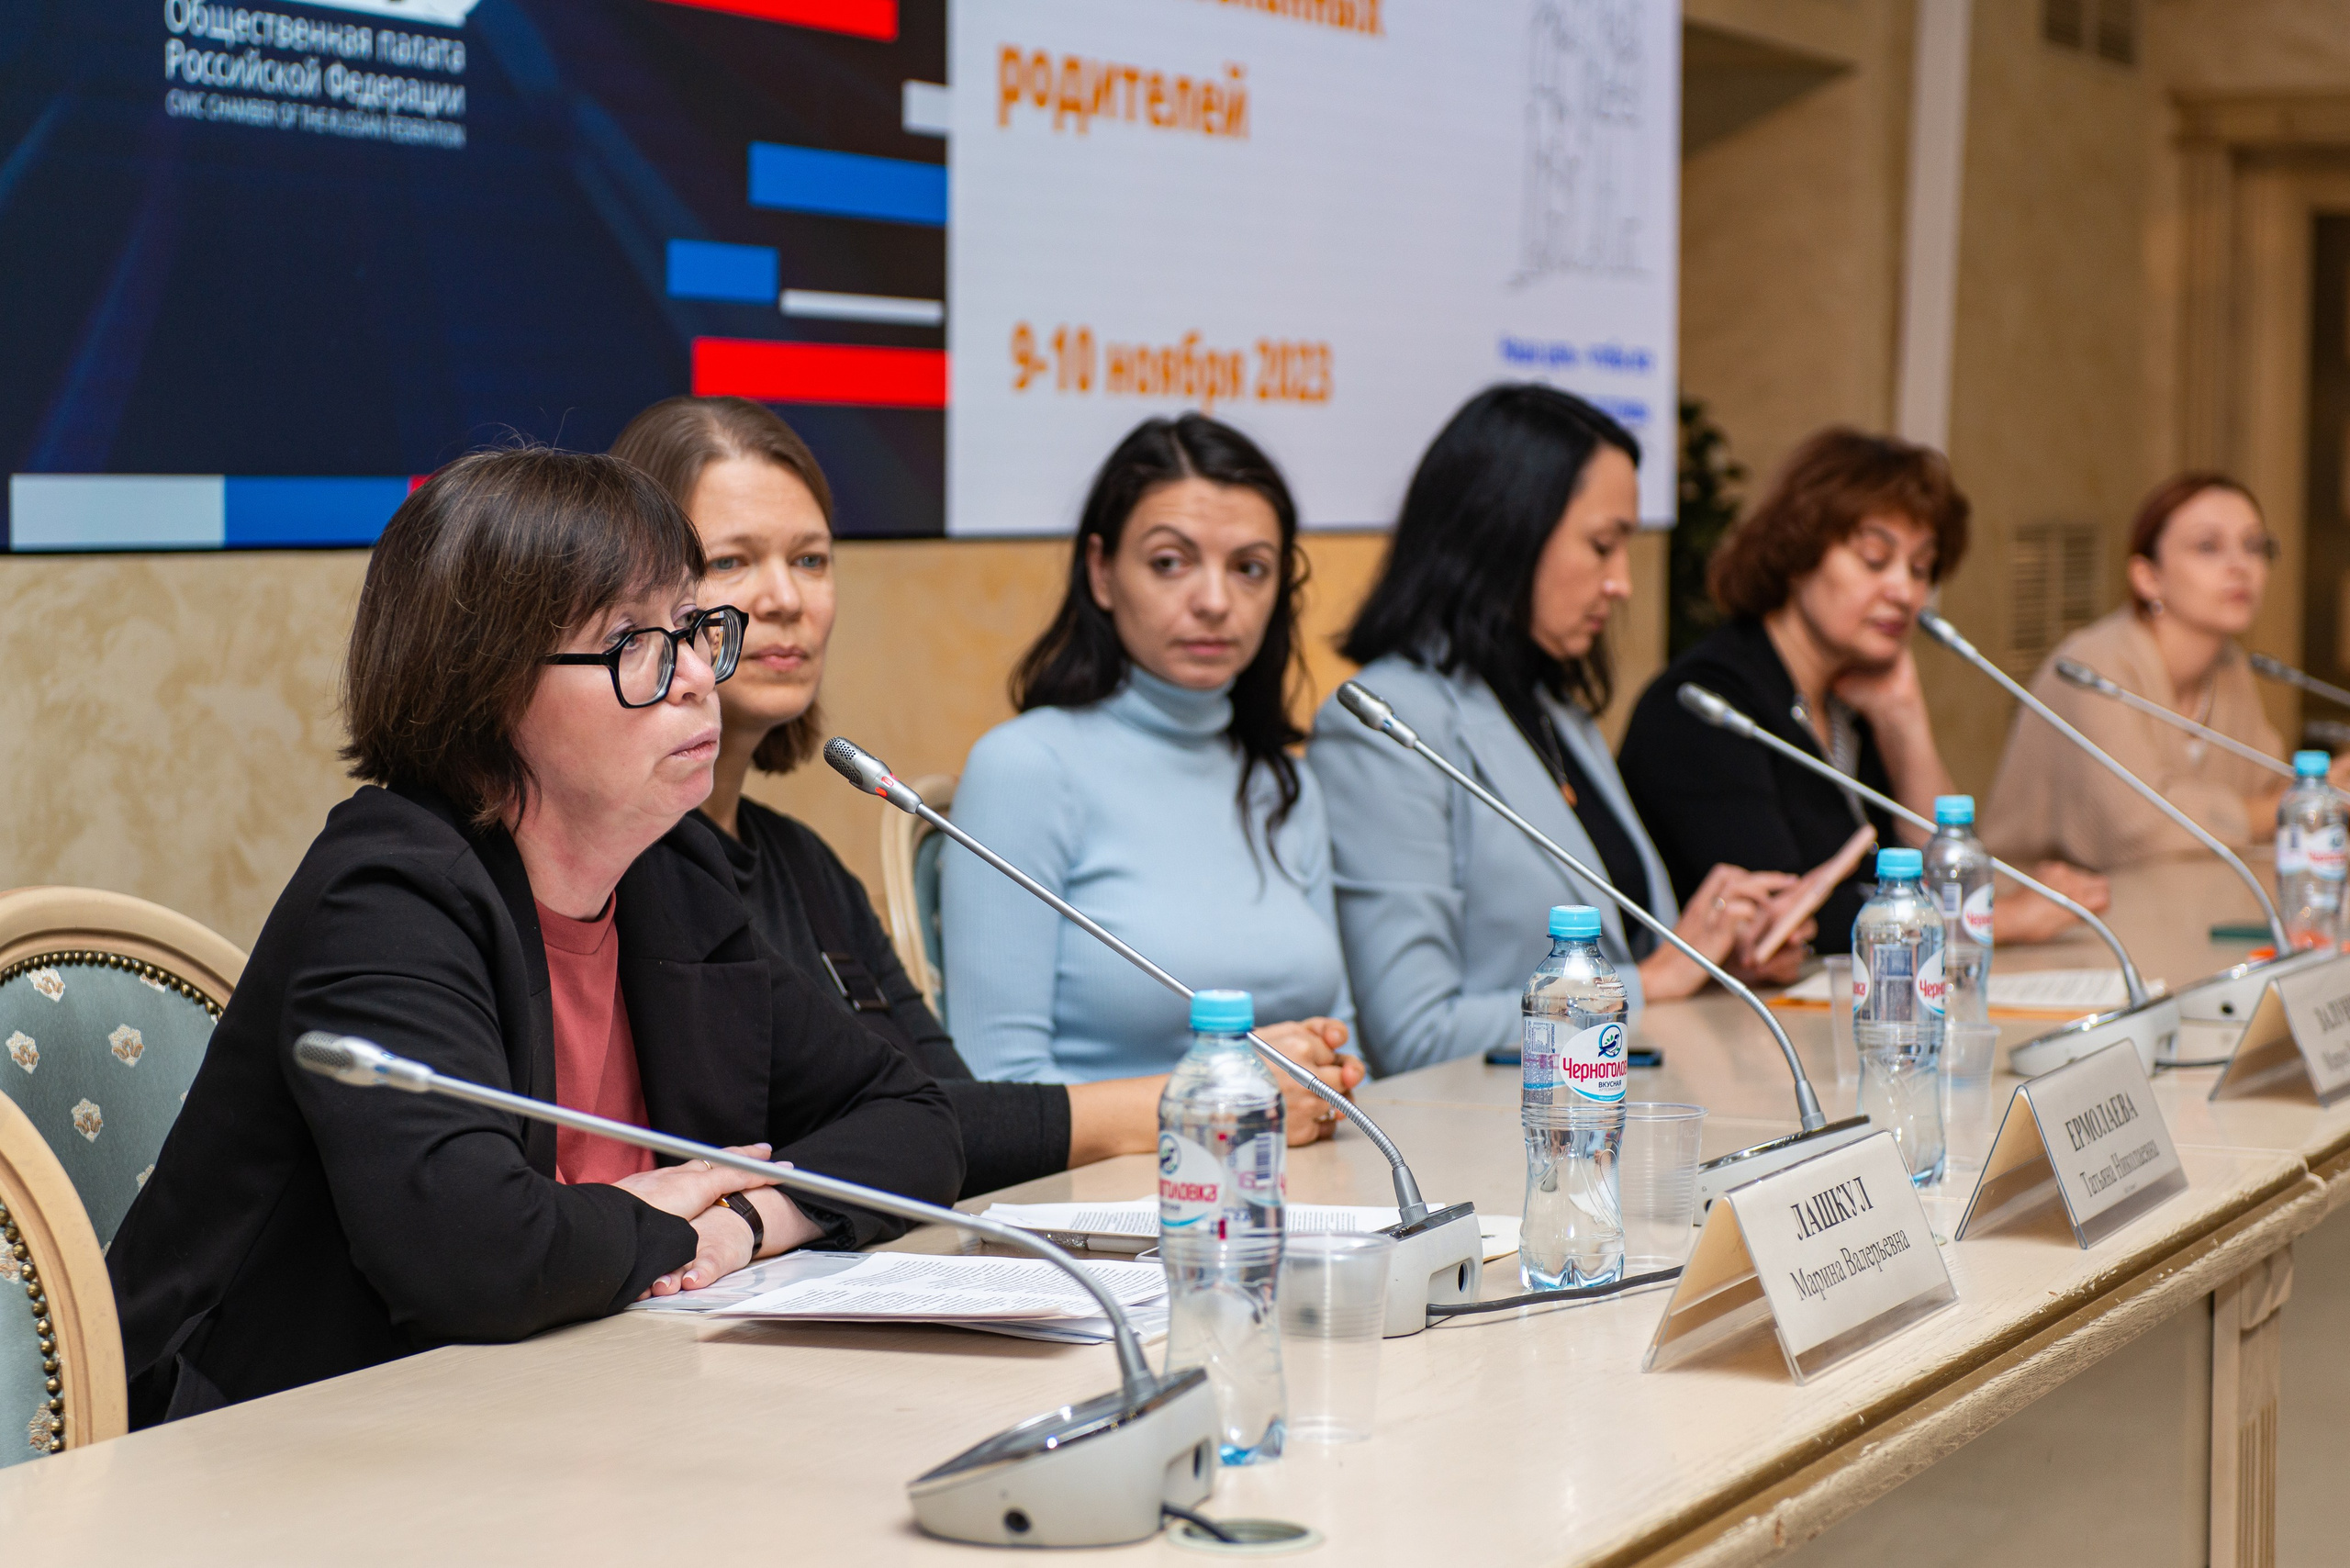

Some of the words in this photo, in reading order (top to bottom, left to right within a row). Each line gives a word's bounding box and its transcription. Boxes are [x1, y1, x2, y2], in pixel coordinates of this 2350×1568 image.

[164, 0, 373, 58] Общественная
[375, 30, 466, 73] палата
[165, 38, 321, 97] Российской
[324, 61, 466, 118] Федерации
[998, 44, 1250, 140] родителей
[1012, 321, 1096, 395] 9-10
[1106, 329, 1244, 416] ноября
[1254, 339, 1334, 405] 2023
[2065, 1090, 2139, 1152] ЕРМОЛАЕВА
[2079, 1164, 2118, 1198] Татьяна
[2110, 1139, 2160, 1180] Николаевна
[1790, 1176, 1874, 1241] ЛАШКУЛ
[1790, 1260, 1848, 1301] Марина
[1840, 1229, 1911, 1277] Валерьевна
